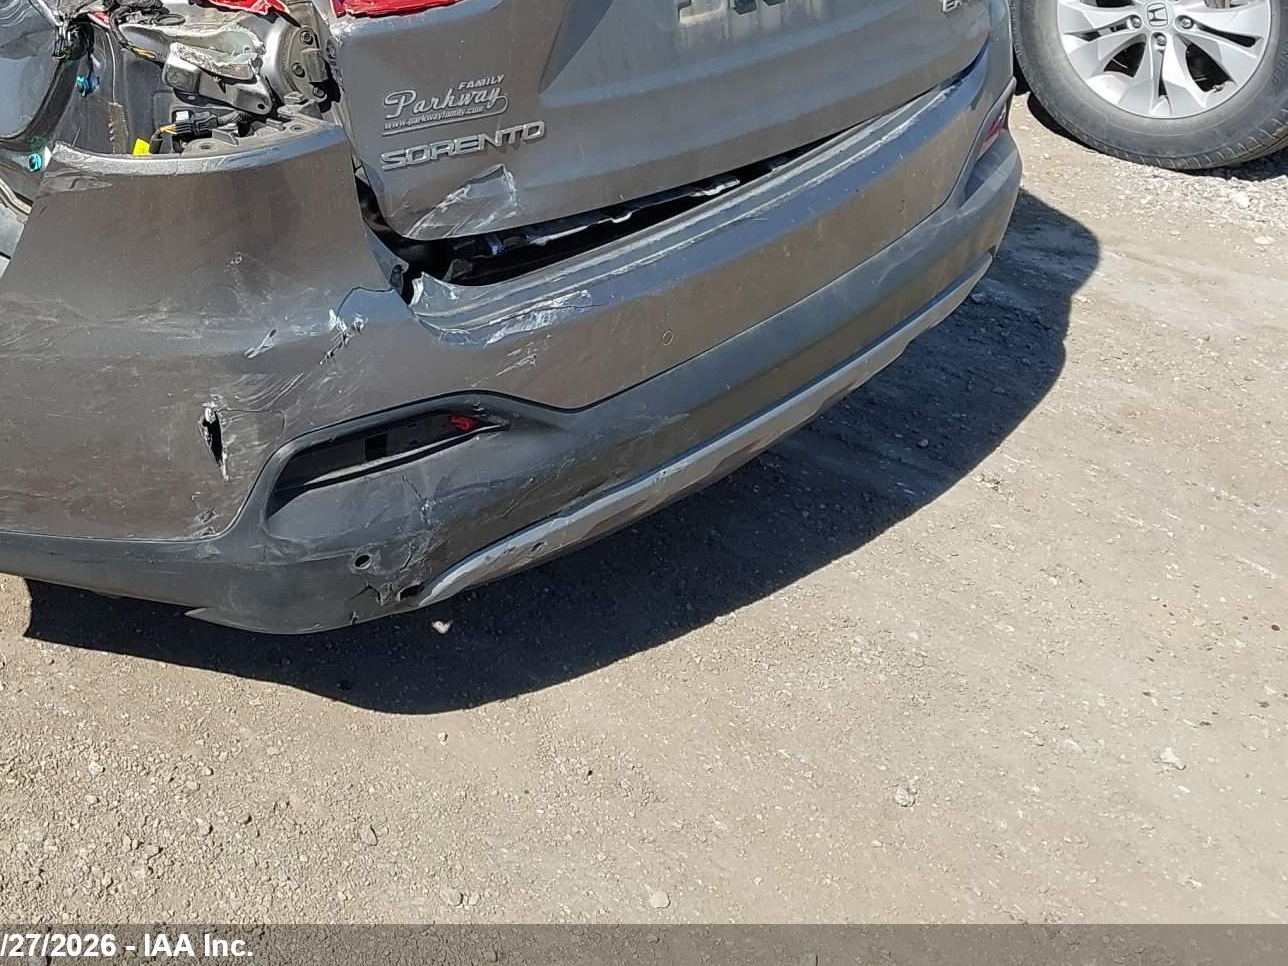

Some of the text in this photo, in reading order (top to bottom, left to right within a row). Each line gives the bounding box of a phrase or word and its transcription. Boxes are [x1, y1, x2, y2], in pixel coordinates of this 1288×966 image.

[458, 74, 505, 91] FAMILY
[383, 87, 508, 120] Parkway
[381, 120, 546, 172] SORENTO
